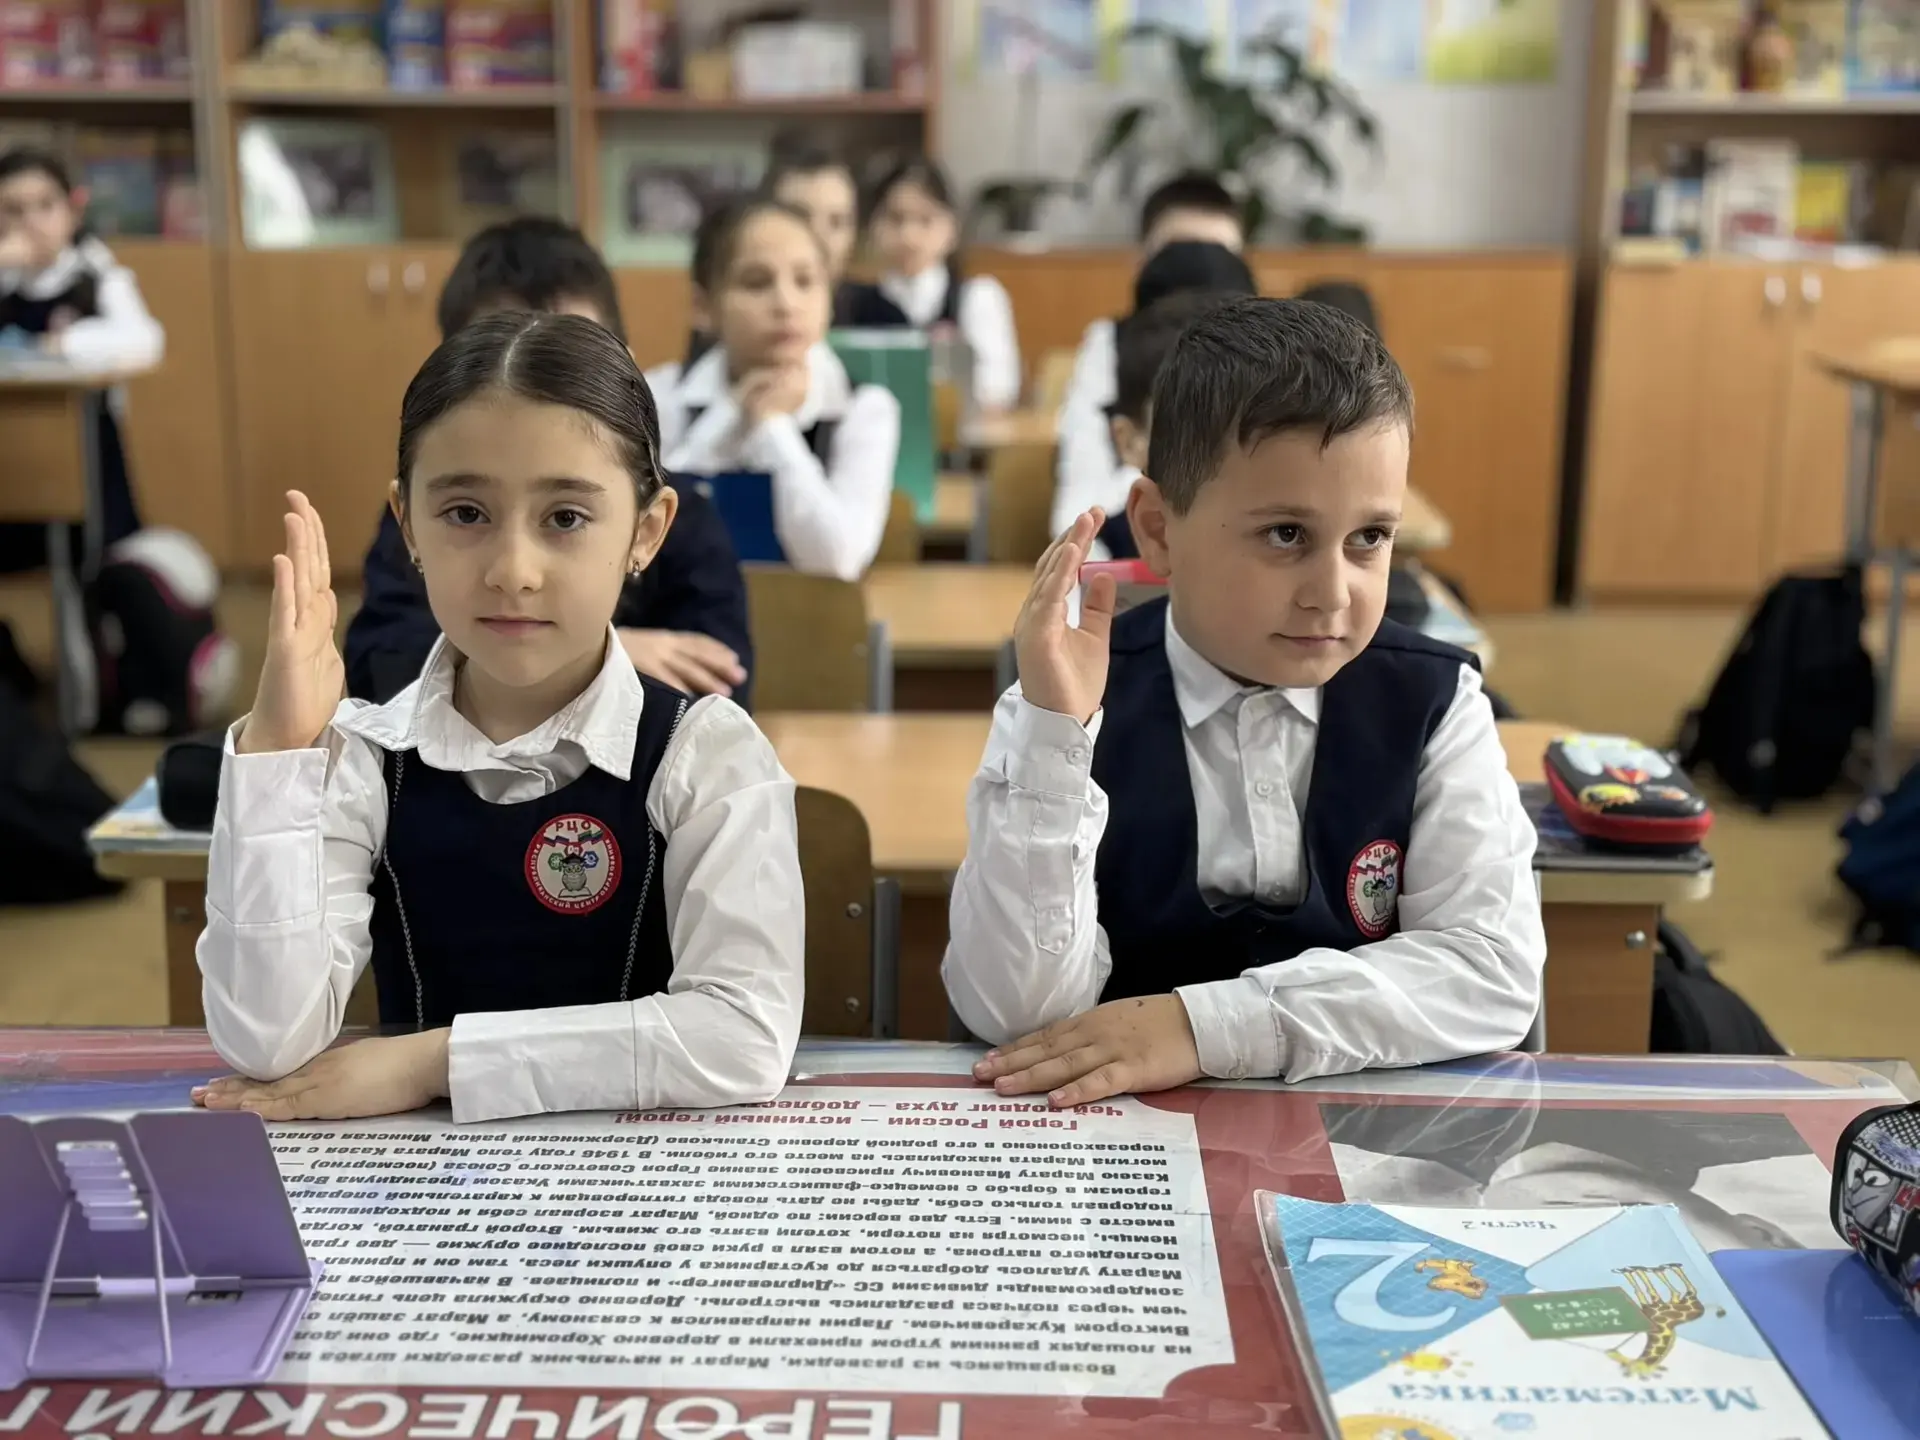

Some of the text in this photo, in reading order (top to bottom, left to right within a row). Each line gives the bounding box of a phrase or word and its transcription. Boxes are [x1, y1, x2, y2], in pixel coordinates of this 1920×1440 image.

[555, 820, 592, 833] РЦО
[1365, 845, 1391, 860] РЦО
[896, 1100, 1123, 1117] Чей духа
[614, 1112, 1077, 1131] Герой России истинный герой!
[341, 1132, 432, 1141] Минская
[441, 1132, 507, 1143] район,
[512, 1133, 659, 1145] (Дзержинский
[666, 1136, 770, 1147] Станьково
[778, 1137, 860, 1147] деревне
[866, 1138, 937, 1148] родной
[945, 1141, 977, 1149] его
[1002, 1141, 1165, 1152] перезахоронено
[307, 1146, 319, 1154] с
[325, 1146, 387, 1156] Казея
[393, 1146, 470, 1157] Марата
[477, 1148, 522, 1156] тело
[529, 1147, 575, 1157] году
[582, 1150, 629, 1159] 1946
[638, 1150, 651, 1159] В
[661, 1151, 737, 1159] гибели.
[785, 1152, 843, 1160] месте
[851, 1153, 874, 1161] на
[882, 1154, 1001, 1162] находилась
[1009, 1155, 1085, 1165] Марата
[1093, 1158, 1167, 1166] могила
[311, 1159, 1169, 1182] Казею Марату Ивановичу присвоено звание Героя Советского Союза (посмертно)
[336, 1174, 466, 1185] Президиума
[473, 1177, 549, 1187] Указом
[557, 1179, 705, 1187] захватчиками
[713, 1180, 958, 1192] немецко-фашистскими
[985, 1184, 1057, 1194] борьбе
[1066, 1186, 1076, 1194] в
[1084, 1186, 1170, 1196] героизм
[385, 1191, 523, 1202] карательной
[549, 1193, 686, 1202] гитлеровцам
[694, 1194, 768, 1203] повода
[777, 1195, 824, 1205] дать
[832, 1197, 855, 1205] не
[863, 1197, 920, 1208] дабы
[928, 1199, 983, 1209] себя,
[991, 1200, 1062, 1209] только
[1071, 1200, 1172, 1211] подорвал
[303, 1205, 450, 1216] подходивших
[477, 1208, 527, 1217] себя
[534, 1208, 623, 1218] взорвал
[630, 1208, 698, 1221] Марат
[709, 1210, 779, 1222] одной,
[787, 1212, 811, 1221] по
[819, 1211, 901, 1222] версии:
[909, 1213, 947, 1222] две
[955, 1215, 1001, 1225] Есть
[1011, 1216, 1072, 1225] ними.
[1080, 1218, 1091, 1226] с
[1100, 1218, 1175, 1228] вместе
[1461, 1220, 1559, 1230] Часть 2
[300, 1221, 1177, 1245] Немцы, несмотря на потери, хотели взять его живым. Второй гранатой, когда
[356, 1239, 397, 1248] две
[436, 1239, 520, 1249] оружие
[527, 1241, 646, 1251] последнее
[654, 1243, 704, 1253] своё
[712, 1242, 763, 1253] руки
[791, 1245, 842, 1254] взял
[850, 1246, 915, 1256] потом
[924, 1247, 936, 1255] а
[946, 1246, 1041, 1258] патрона,
[1050, 1249, 1179, 1261] последнего
[327, 1255, 1181, 1279] Марату удалось добраться до кустарника у опушки леса, там он и принял
[348, 1274, 1183, 1297] зондеркоманды дивизии СС «Дирлевангер» полицаев. начавшейся
[1307, 1237, 1457, 1332] 2
[392, 1292, 1187, 1315] чем через полчаса раздались выстрелы. Деревню окружила цепь
[328, 1312, 1189, 1337] Виктором Кухаревичем. Ларин направился связному, Марат зашёл
[346, 1330, 1192, 1354] на лошадях ранним утром приехали деревню Хоромицкие, где они
[320, 1351, 1116, 1376] Возвращаясь из разведки, Марат начальник разведки штаба
[1387, 1383, 1766, 1412] Математика
[63, 1388, 963, 1440] ГЕРОИЧЕСКИЙ
